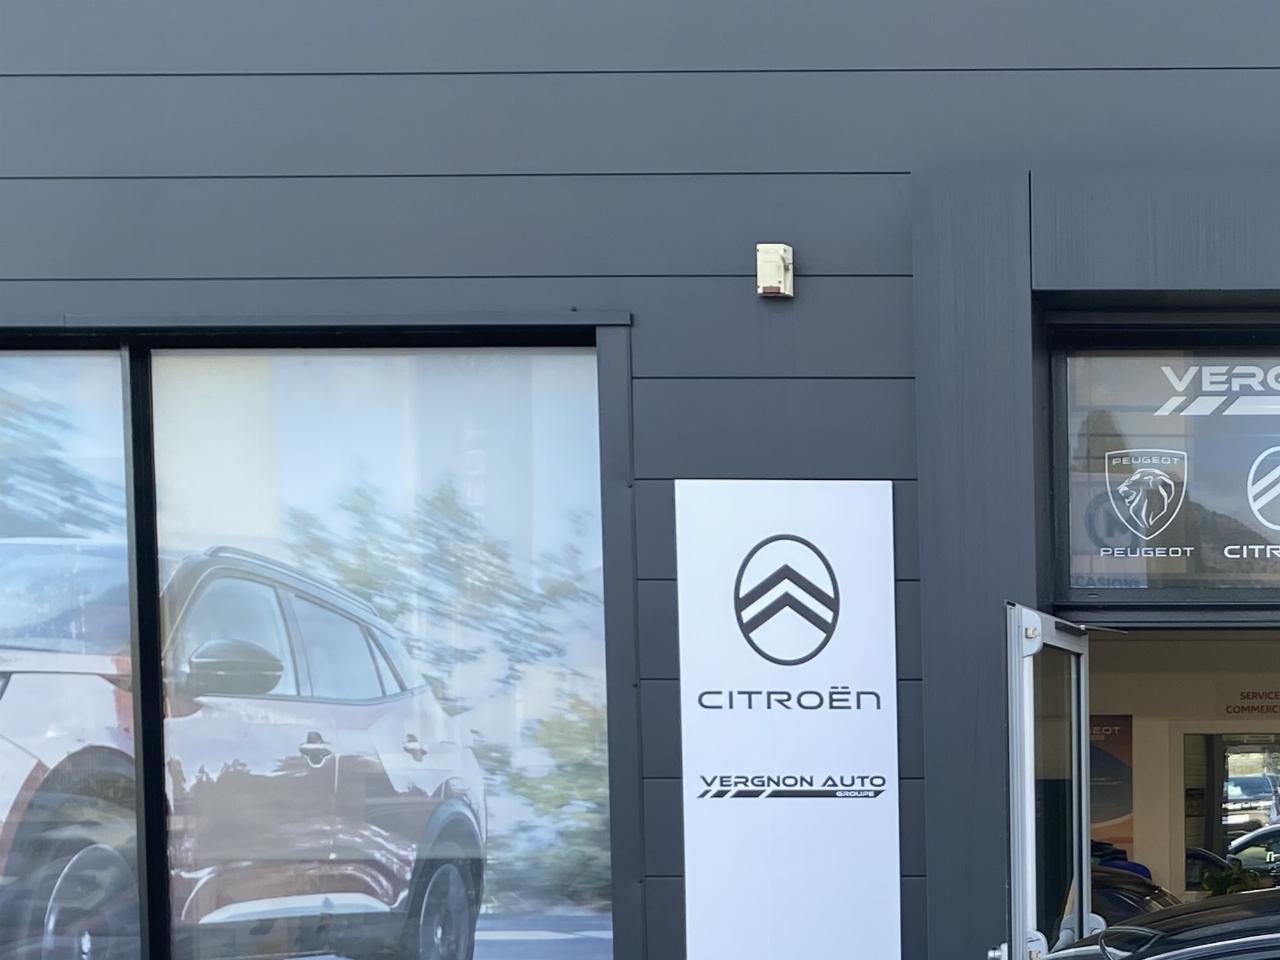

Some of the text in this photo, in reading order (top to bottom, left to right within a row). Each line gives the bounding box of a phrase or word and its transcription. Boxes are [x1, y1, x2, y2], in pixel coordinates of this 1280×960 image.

[1112, 456, 1181, 467] PEUGEOT
[1100, 547, 1195, 557] PEUGEOT
[1240, 691, 1280, 700] SERVICE
[700, 775, 886, 788] VERGNON AUTO
